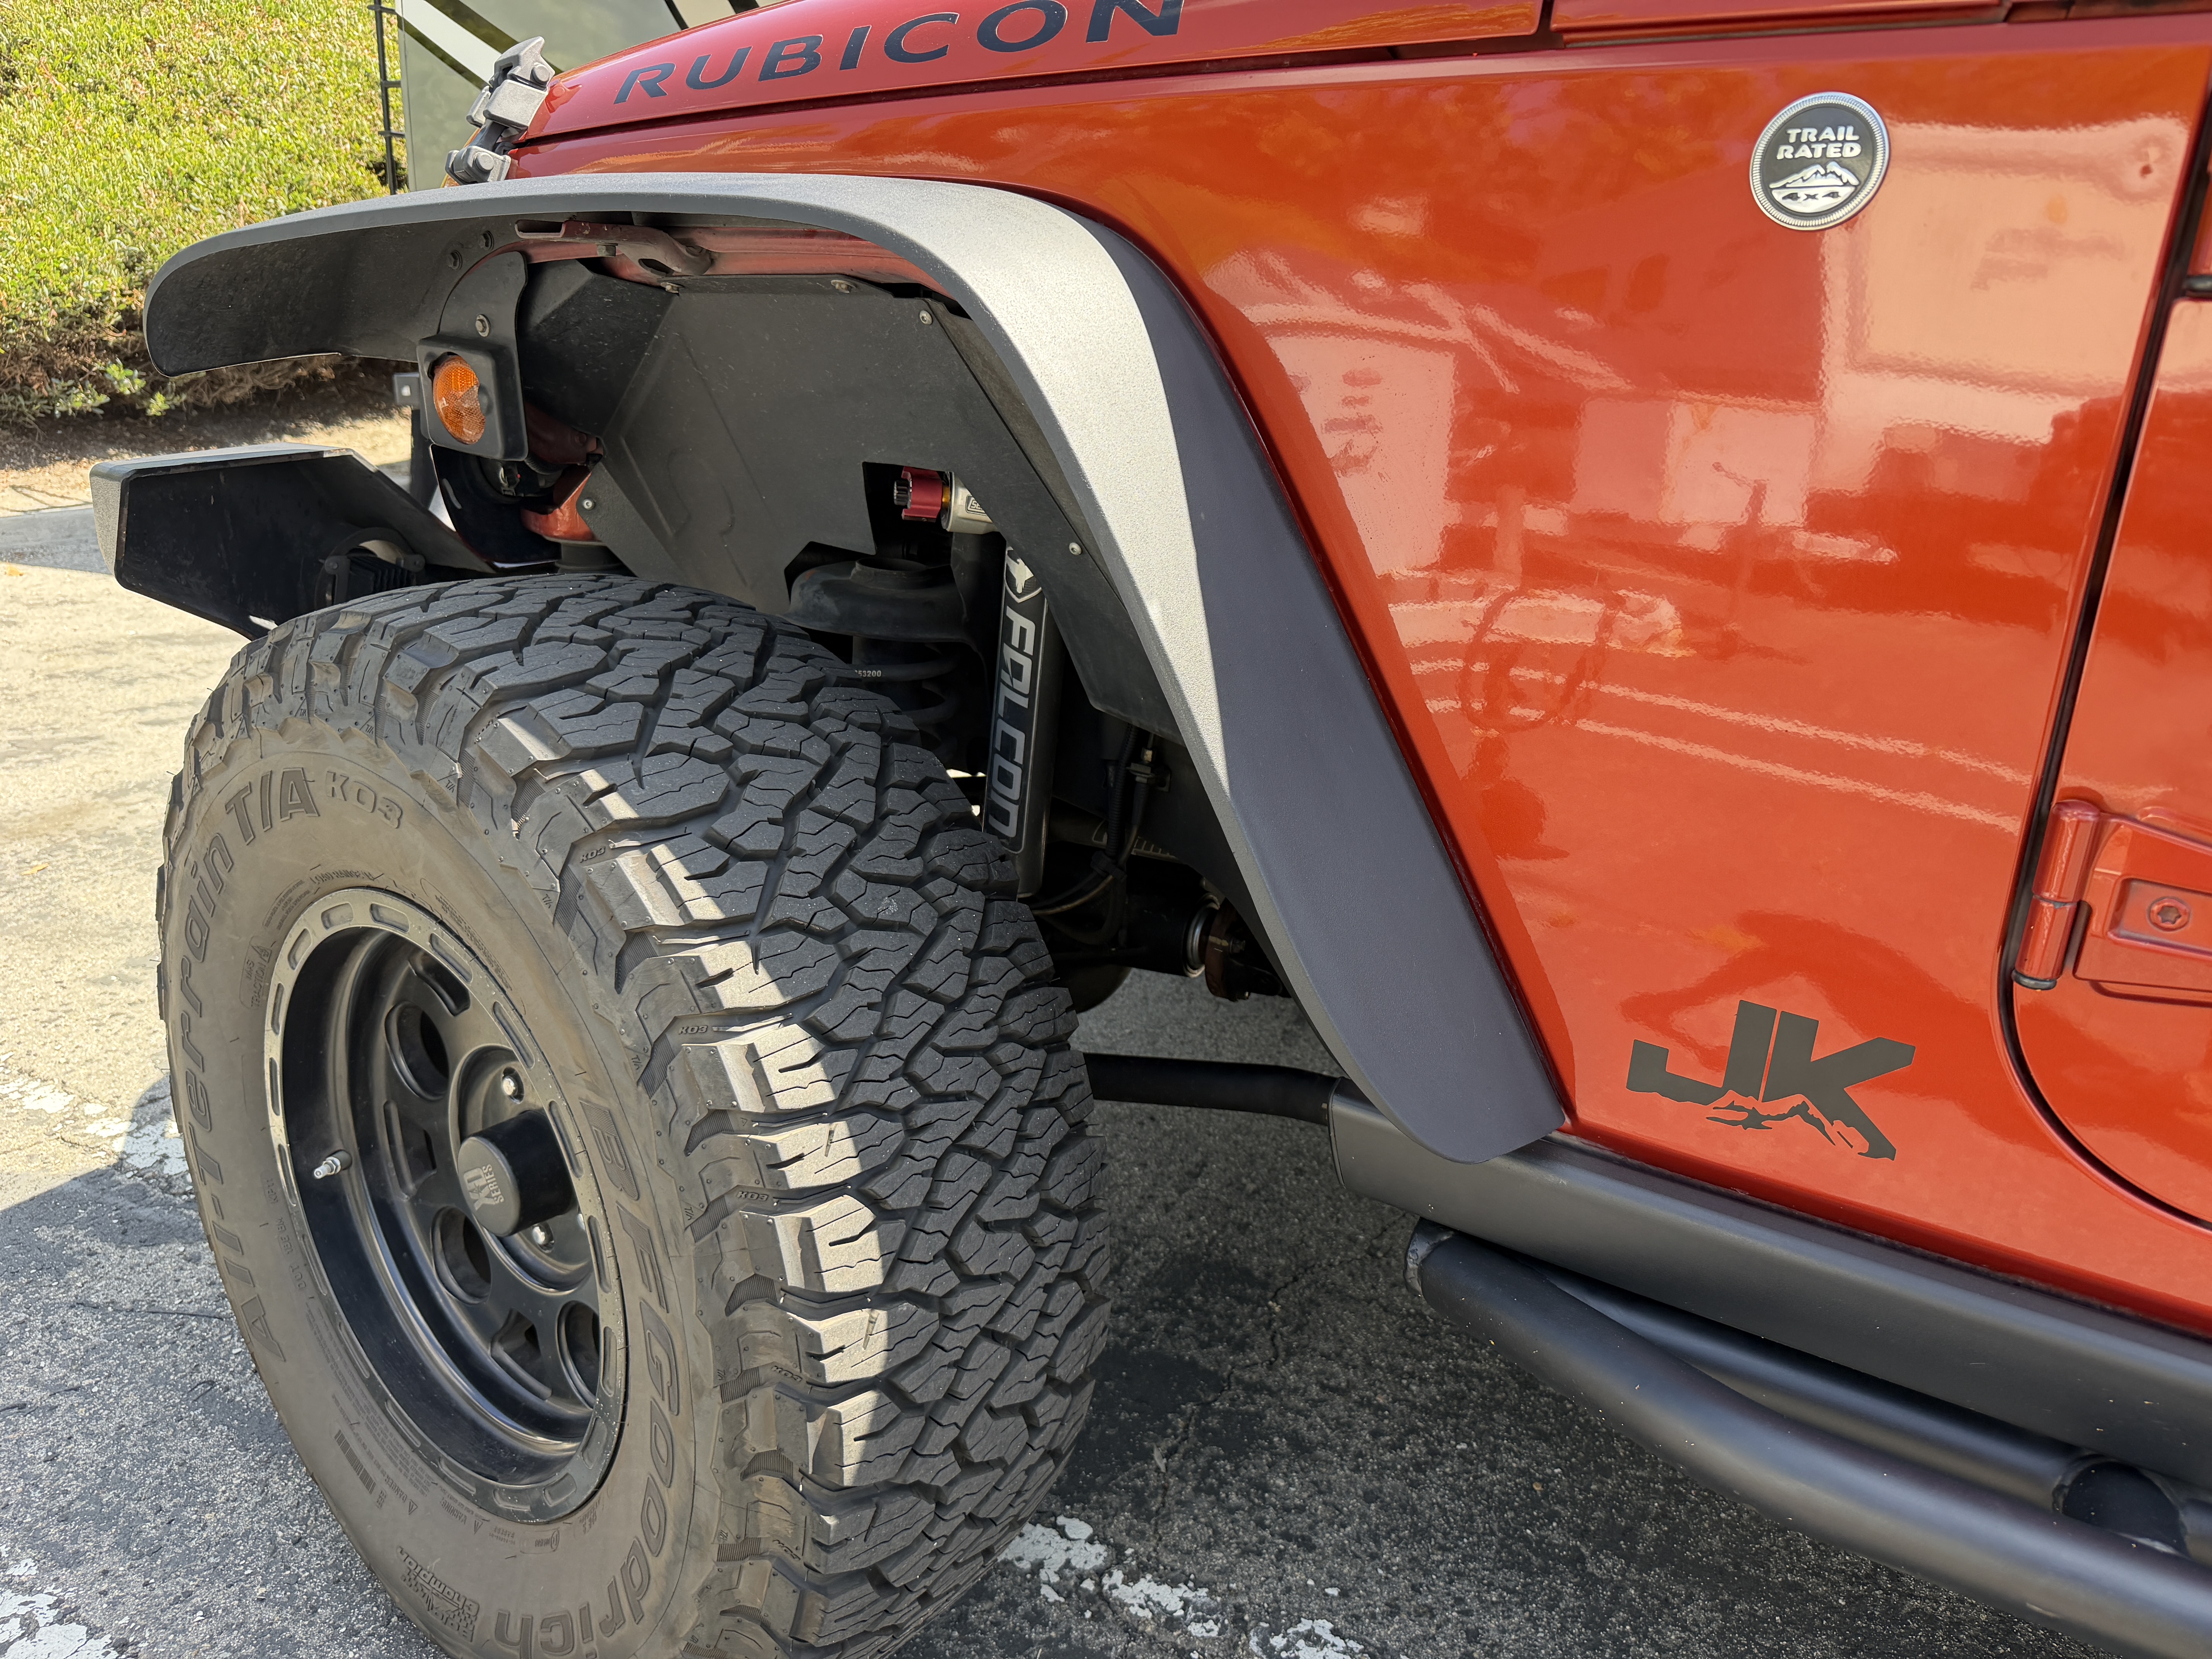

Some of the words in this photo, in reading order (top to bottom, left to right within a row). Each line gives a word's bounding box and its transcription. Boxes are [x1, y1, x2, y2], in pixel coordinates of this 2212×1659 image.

[613, 0, 1185, 105] RUBICON
[1776, 143, 1862, 160] RATED
[1786, 125, 1860, 143] TRAIL
[988, 605, 1036, 839] FALCON
[1626, 999, 1917, 1161] JK
[482, 1163, 504, 1203] SERIES
[290, 1264, 307, 1290] DOT
[494, 1100, 680, 1659] BFGoodrich
[397, 1545, 480, 1617] Champion
